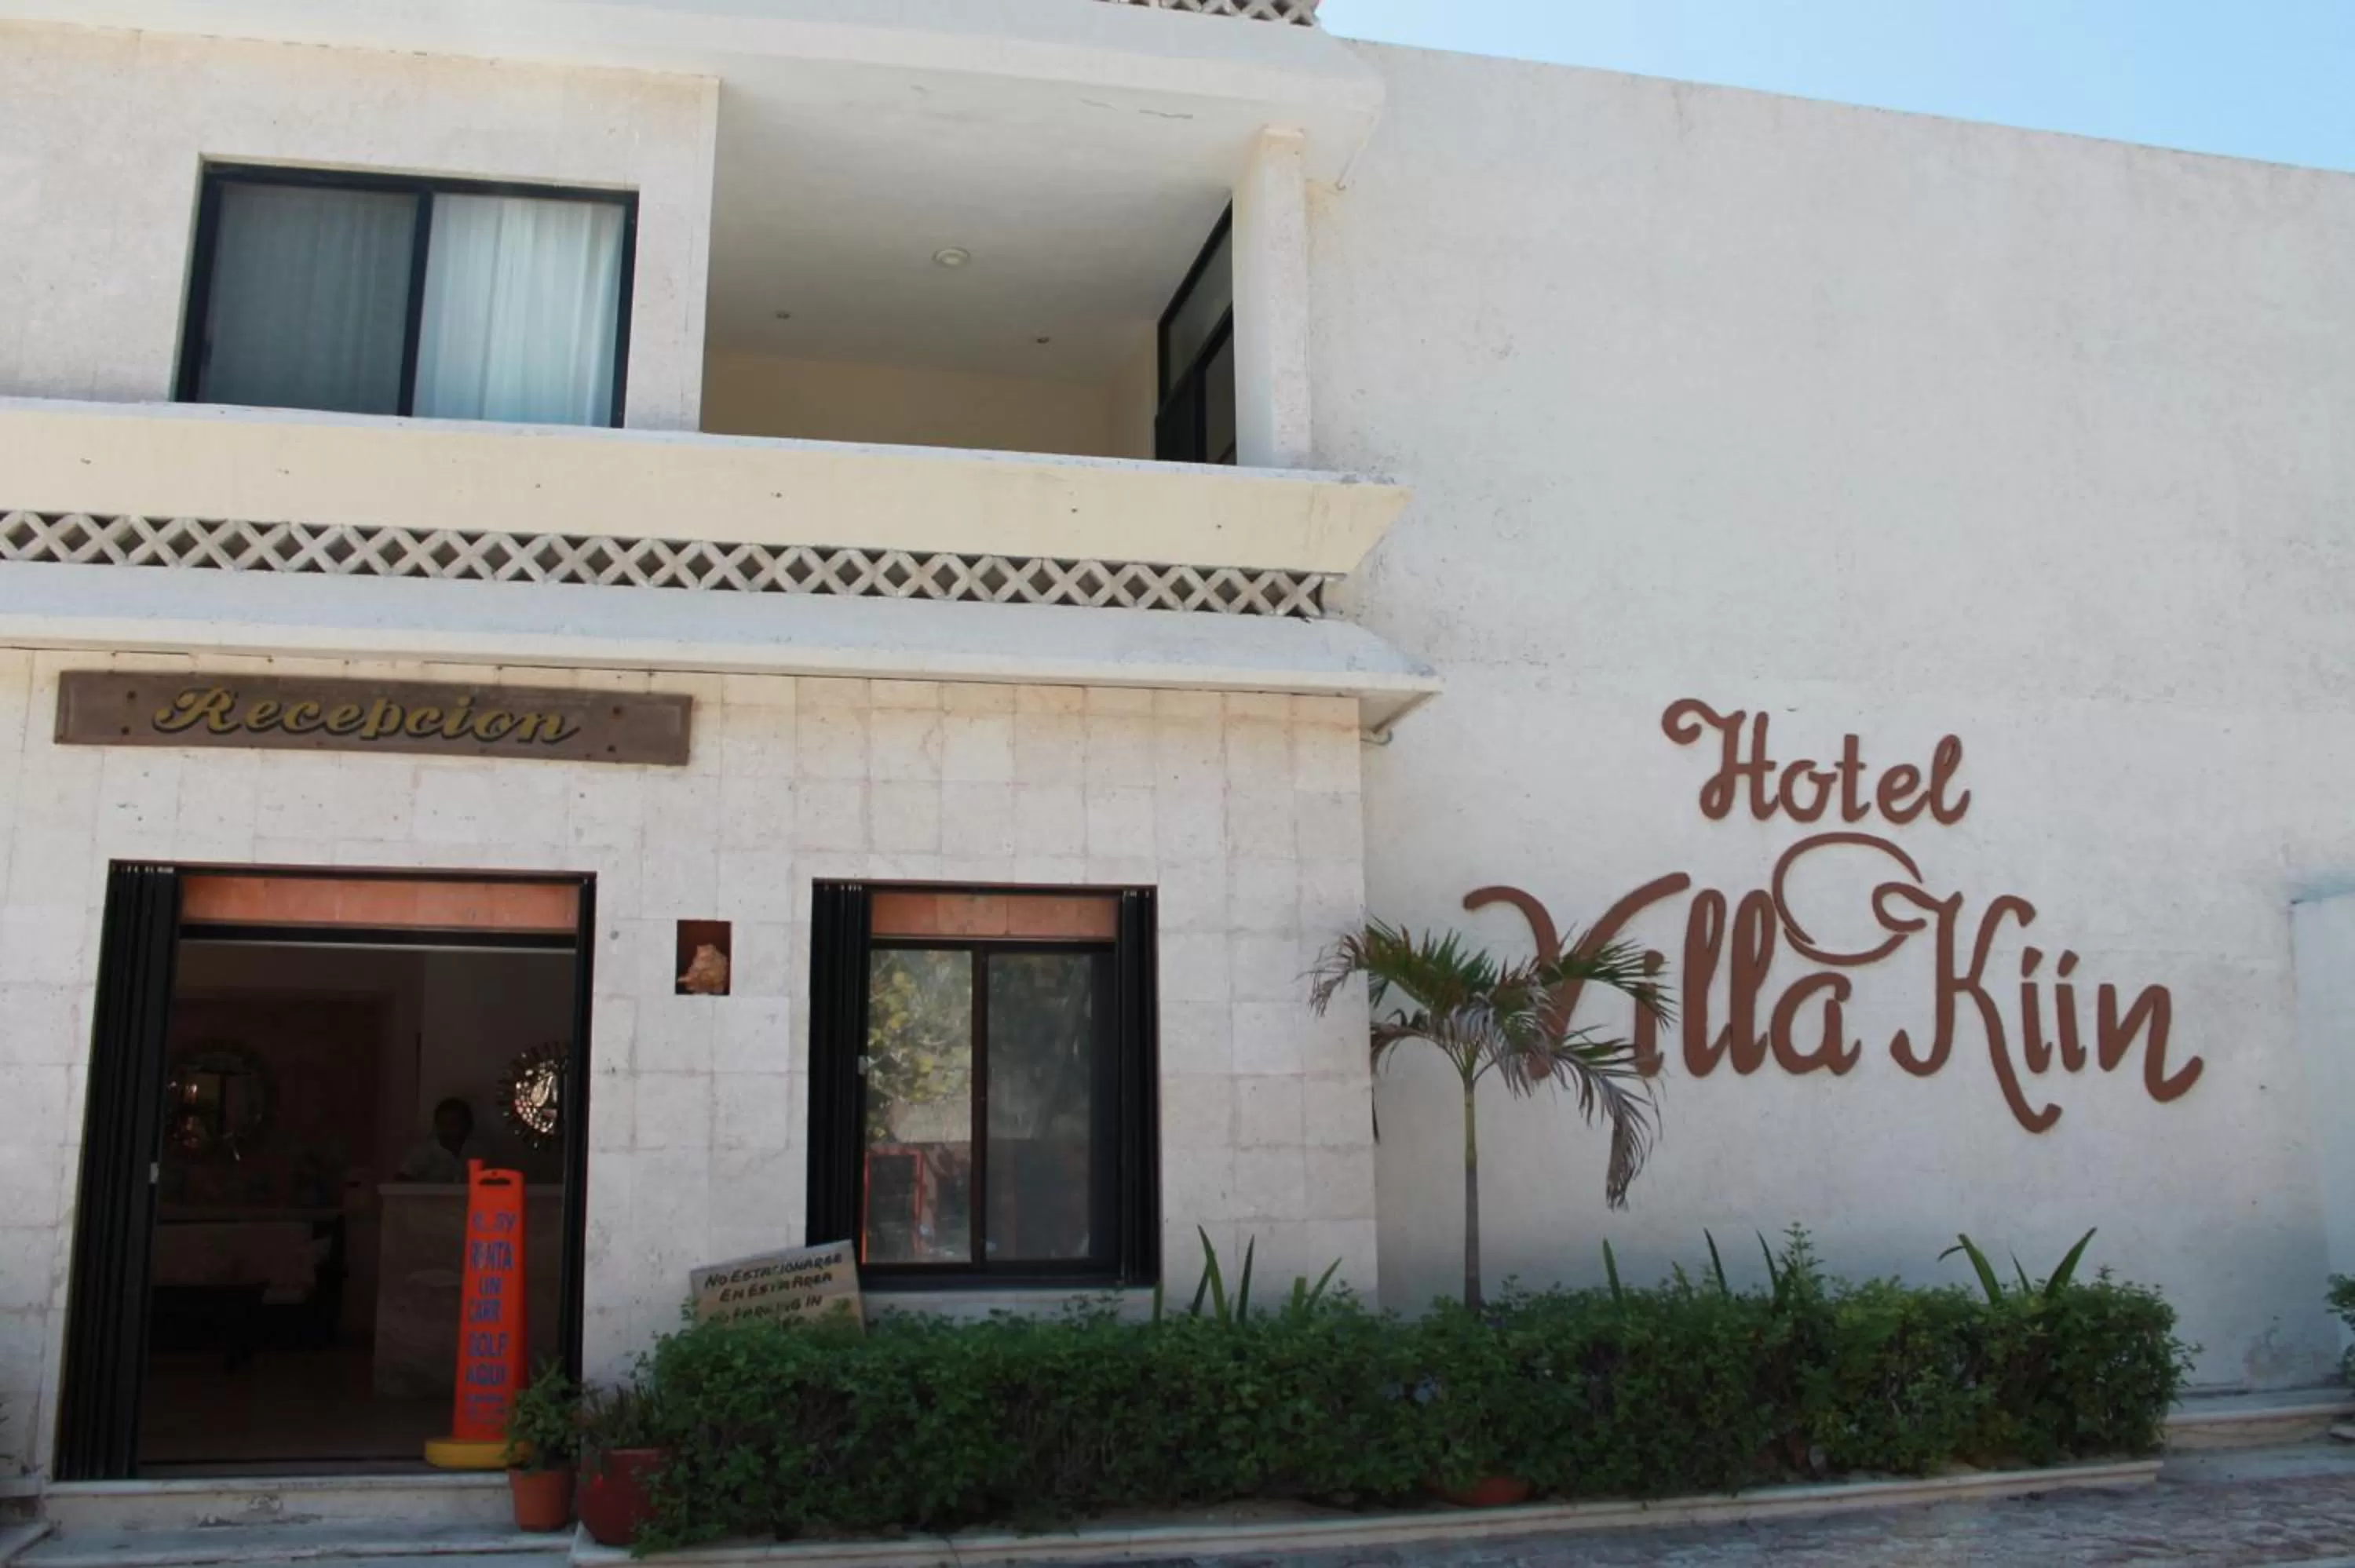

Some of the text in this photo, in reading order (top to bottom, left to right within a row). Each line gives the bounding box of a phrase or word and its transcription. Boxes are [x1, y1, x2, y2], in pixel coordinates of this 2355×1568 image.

[155, 687, 582, 746] Recepcion
[1661, 698, 1971, 826] Hotel
[1462, 872, 2204, 1135] Villa Kiin
[719, 1288, 745, 1303] EN
